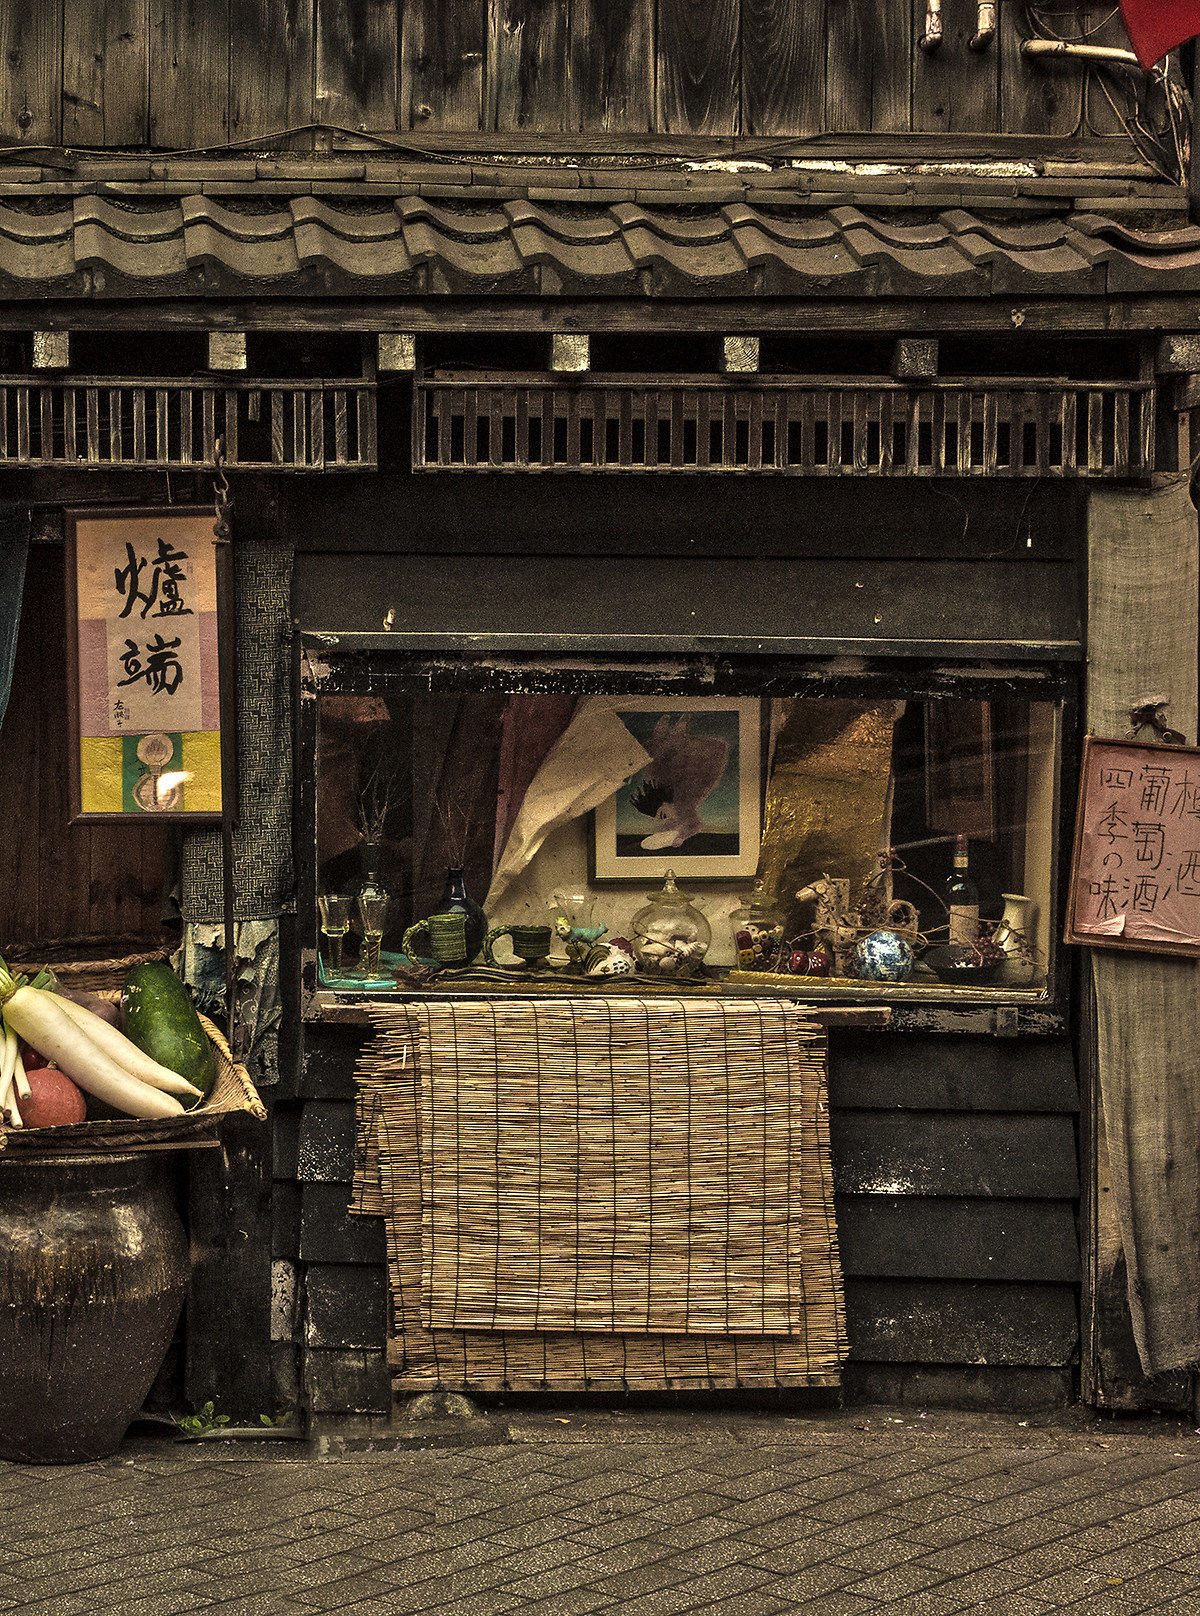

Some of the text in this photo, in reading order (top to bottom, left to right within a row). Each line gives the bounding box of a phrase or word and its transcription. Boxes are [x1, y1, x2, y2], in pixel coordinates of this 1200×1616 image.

[1089, 768, 1134, 918] 四季の味
[1121, 764, 1173, 913] 葡萄酒
